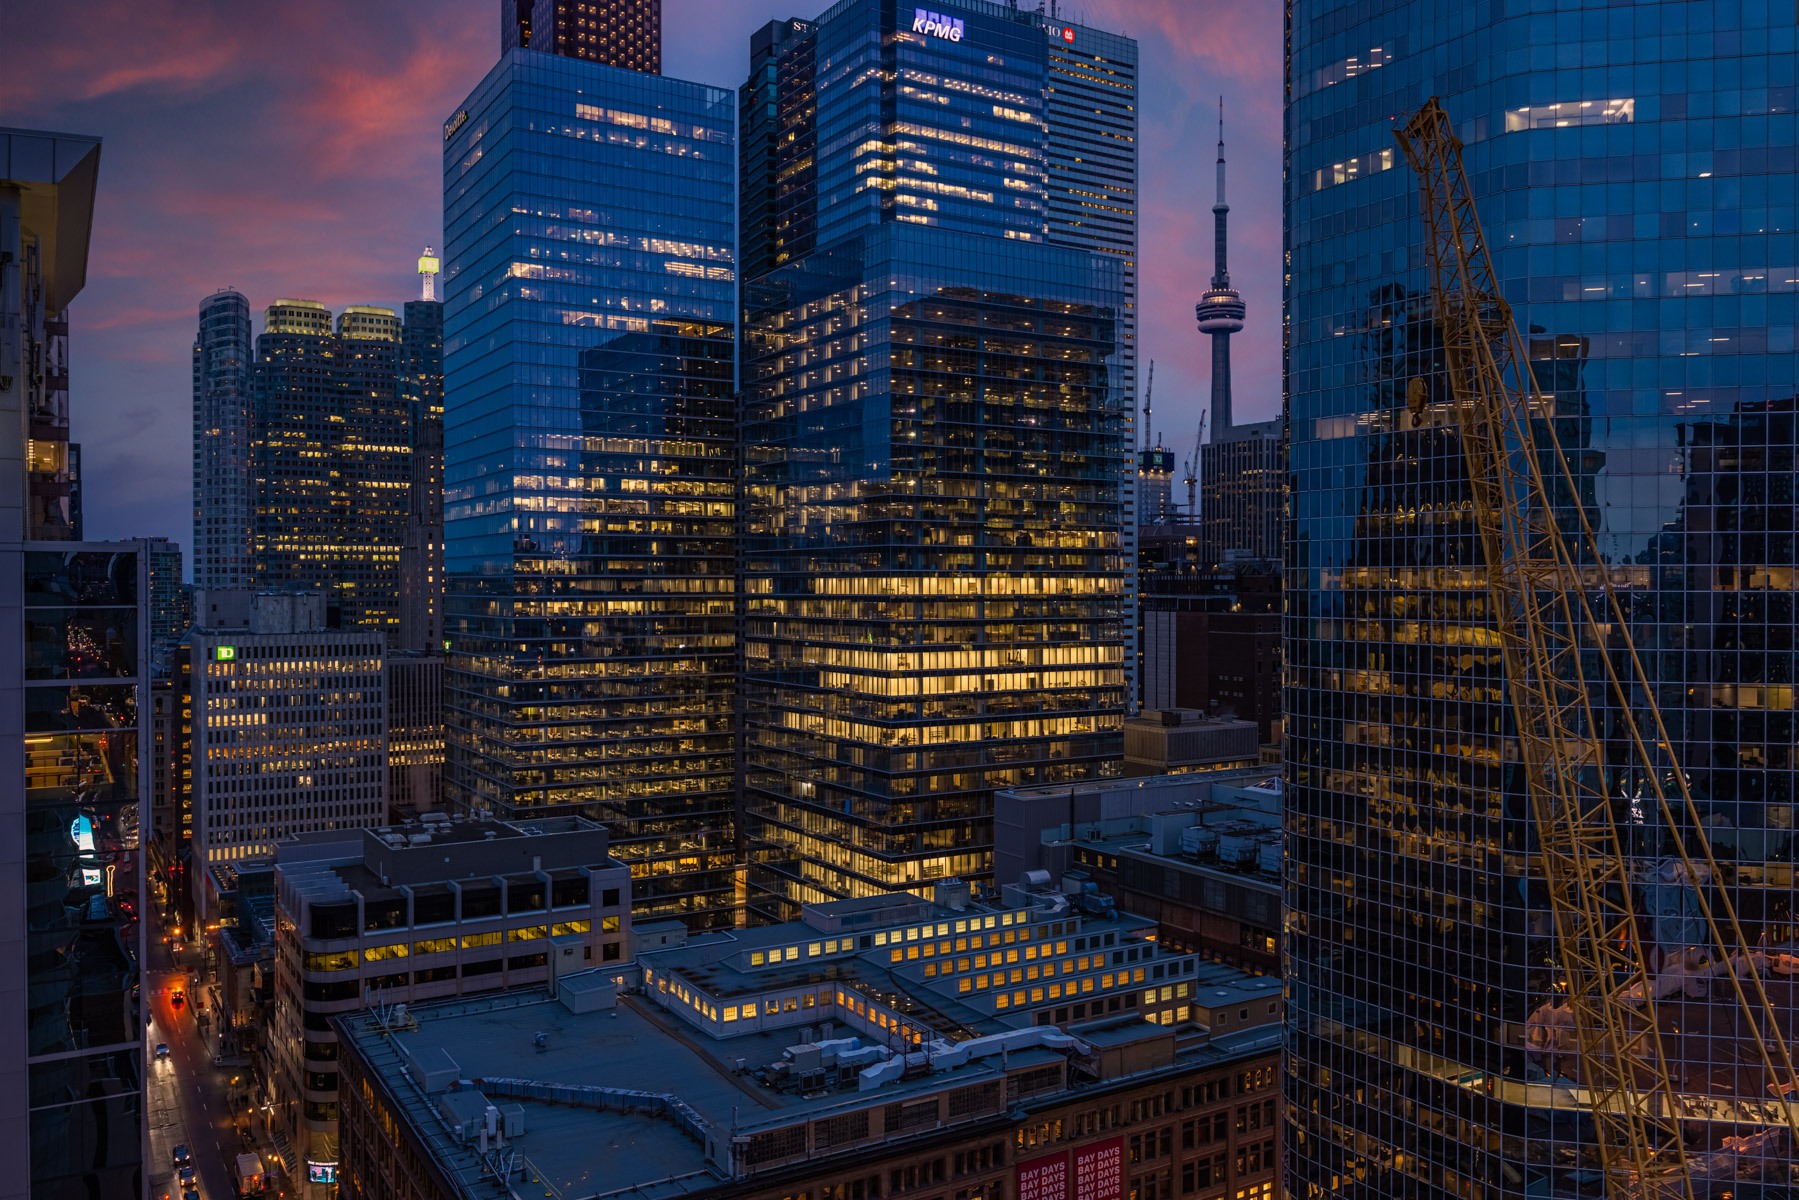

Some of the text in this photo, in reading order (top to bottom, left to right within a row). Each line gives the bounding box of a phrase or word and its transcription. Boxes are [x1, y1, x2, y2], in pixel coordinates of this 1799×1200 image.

[912, 17, 961, 42] KPMG
[218, 648, 234, 658] TD
[1078, 1147, 1120, 1165] BAY DAYS
[1078, 1156, 1120, 1175] BAY DAYS
[1021, 1162, 1065, 1181] BAY DAYS
[1078, 1166, 1120, 1185] BAY DAYS
[1021, 1172, 1065, 1191] BAY DAYS
[1021, 1181, 1065, 1200] BAY DAYS
[1078, 1176, 1120, 1194] BAY DAYS
[1098, 1185, 1120, 1198] DAYS
